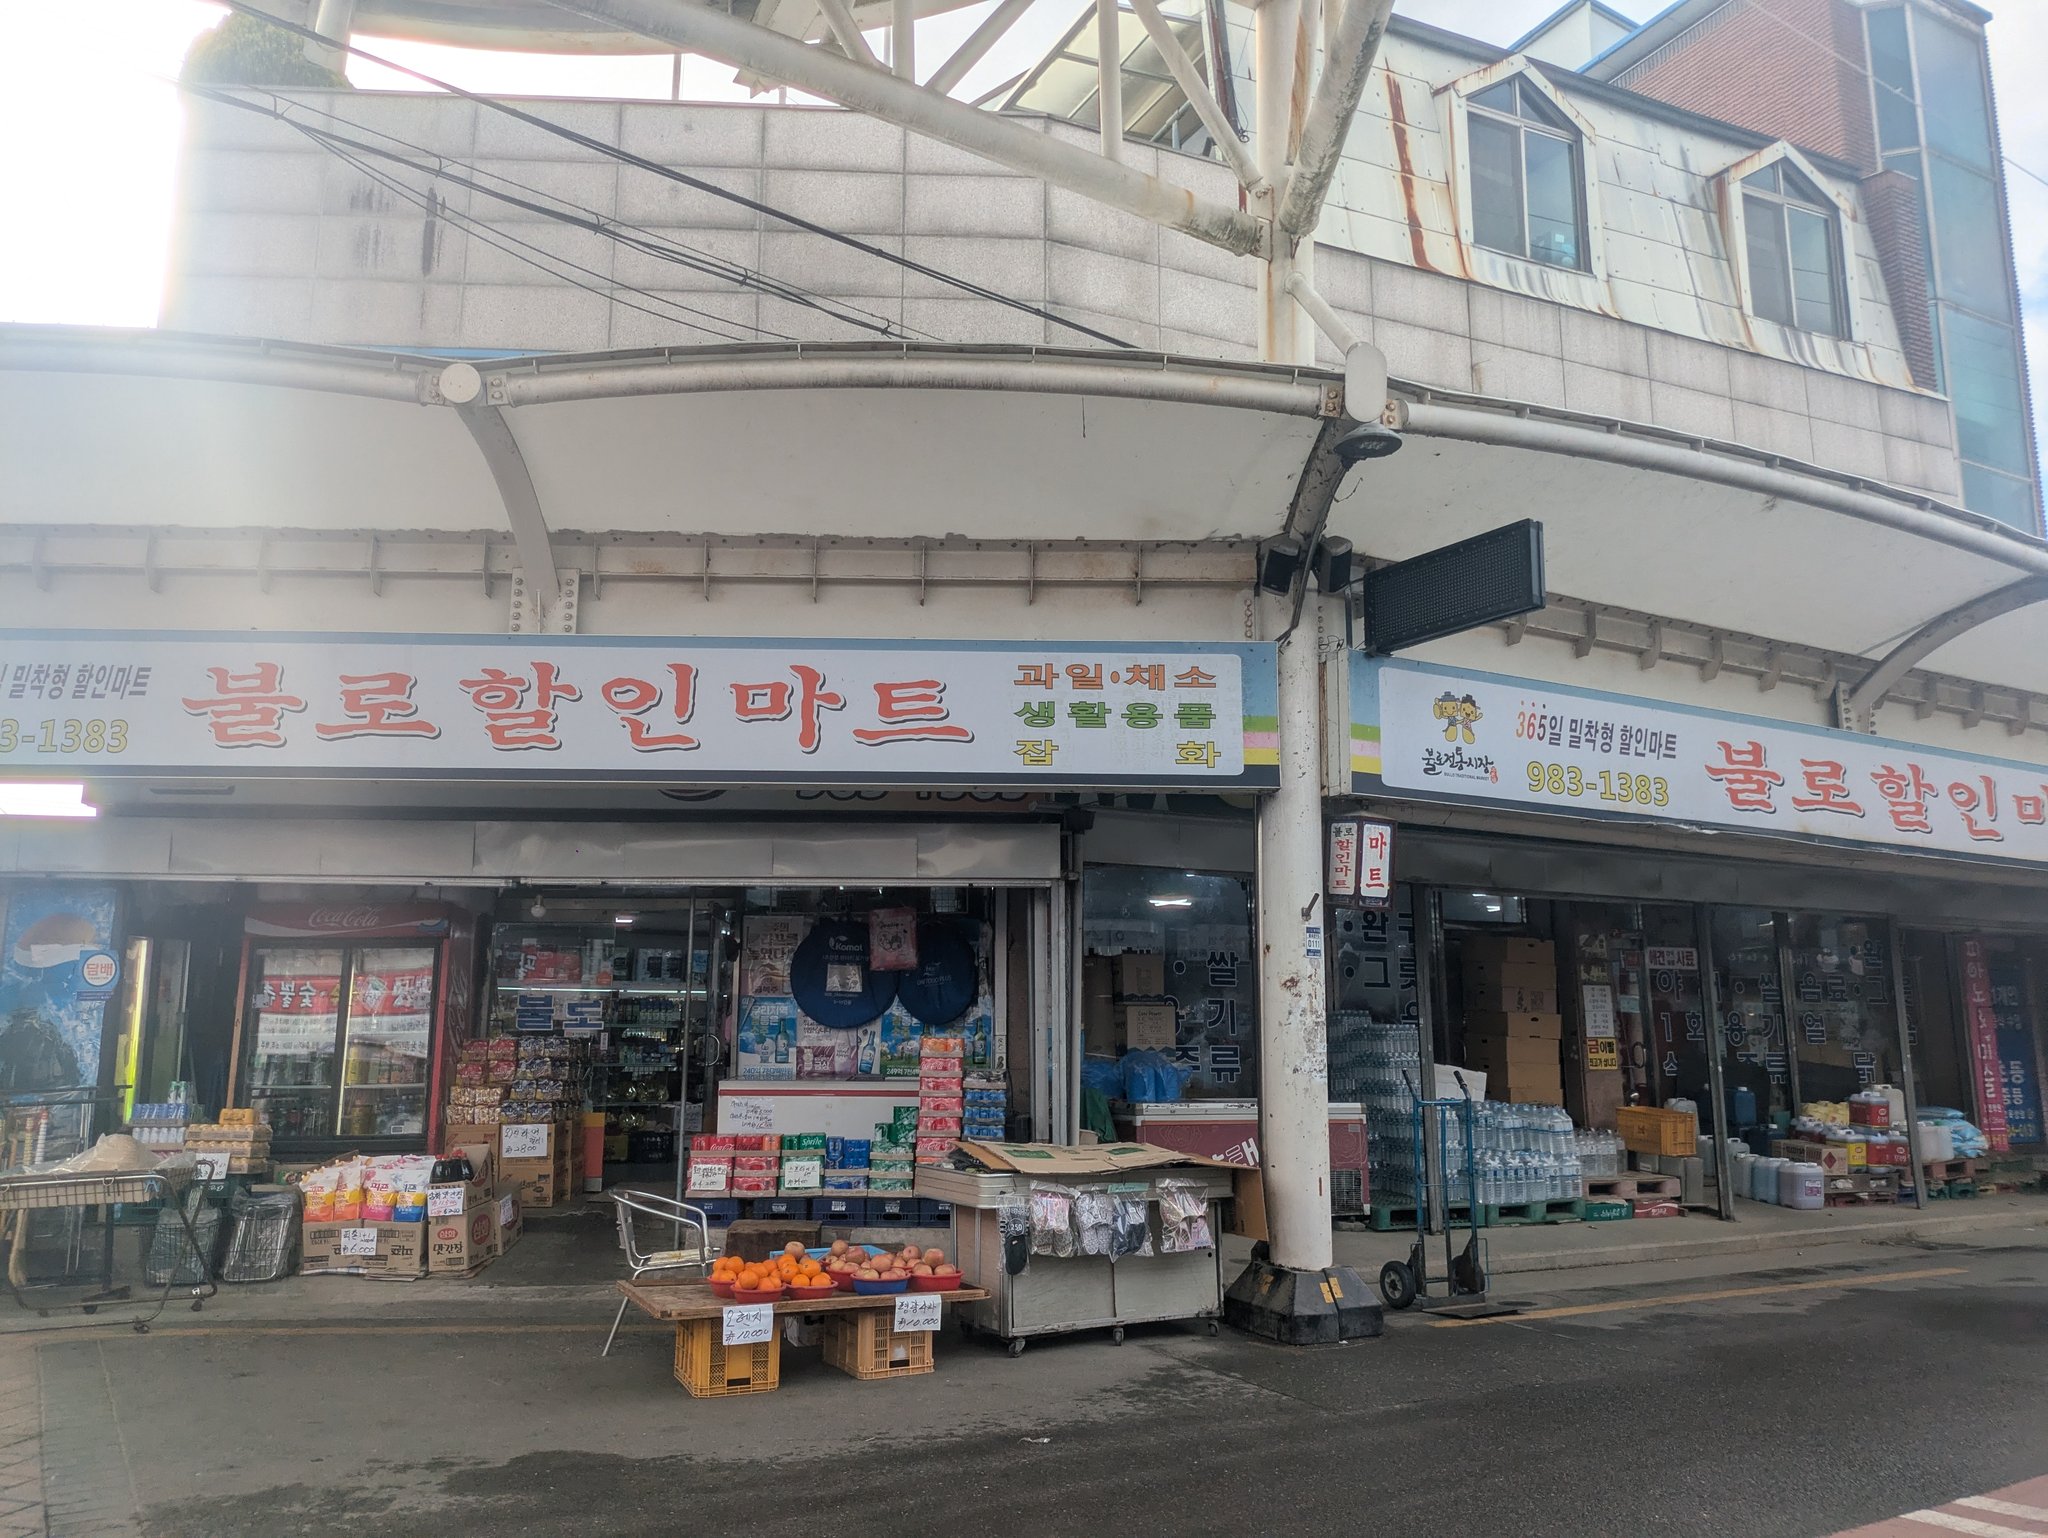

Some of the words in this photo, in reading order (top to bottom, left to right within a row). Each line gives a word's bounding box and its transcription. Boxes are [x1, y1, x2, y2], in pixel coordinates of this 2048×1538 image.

[72, 664, 152, 700] 할인마트
[1013, 663, 1217, 691] 과일·채소
[182, 661, 975, 755] 불로할인마트
[1013, 701, 1218, 729] 생활용품
[1516, 707, 1563, 747] 365일
[1568, 717, 1615, 754] 밀착형
[1619, 724, 1678, 761] 할인마트
[1421, 745, 1495, 776] 불로전통시장
[1526, 760, 1670, 807] 983-1383
[1332, 838, 1353, 889] 할인마트
[1365, 831, 1388, 889] 마트
[309, 904, 382, 928] Coca-Cola
[86, 962, 113, 977] 담배
[1587, 1039, 1615, 1054] 금이빨
[802, 1136, 823, 1147] Sprite
[1010, 1222, 1023, 1230] 250
[432, 1241, 463, 1256] 맛간장
[726, 1308, 763, 1329] 오렌지
